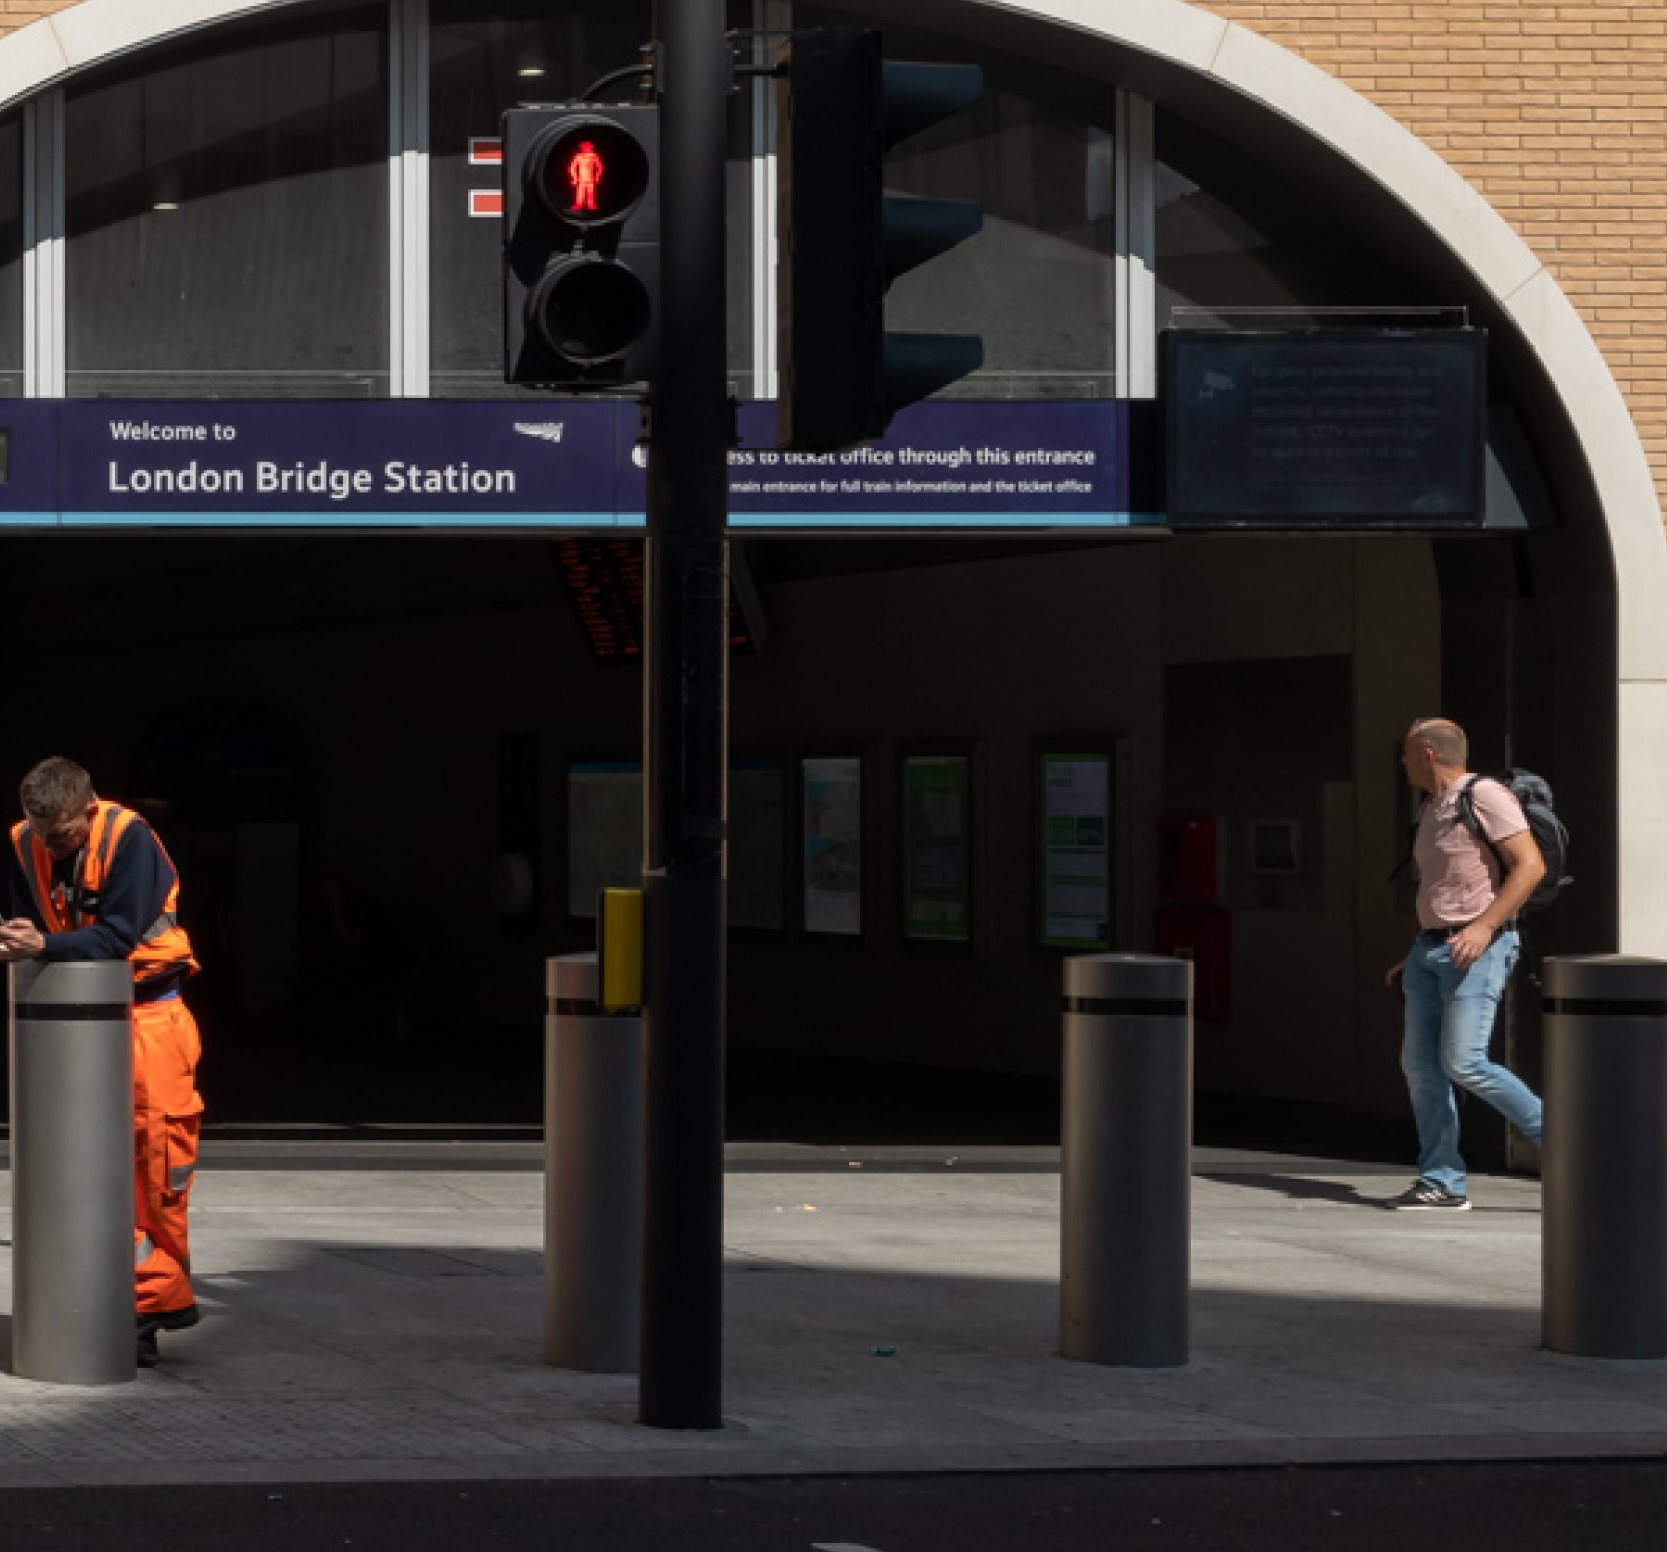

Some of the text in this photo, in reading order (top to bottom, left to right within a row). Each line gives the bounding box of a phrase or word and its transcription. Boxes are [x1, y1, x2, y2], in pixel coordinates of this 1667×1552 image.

[109, 420, 236, 441] Welcome to
[759, 450, 780, 466] to
[784, 450, 836, 466] ticket
[839, 448, 895, 466] office
[898, 446, 972, 469] through
[976, 447, 1011, 466] this
[1014, 447, 1096, 466] entrance
[108, 460, 516, 501] London Bridge Station
[728, 479, 1092, 493] main entrance for full train information and the ticket office
